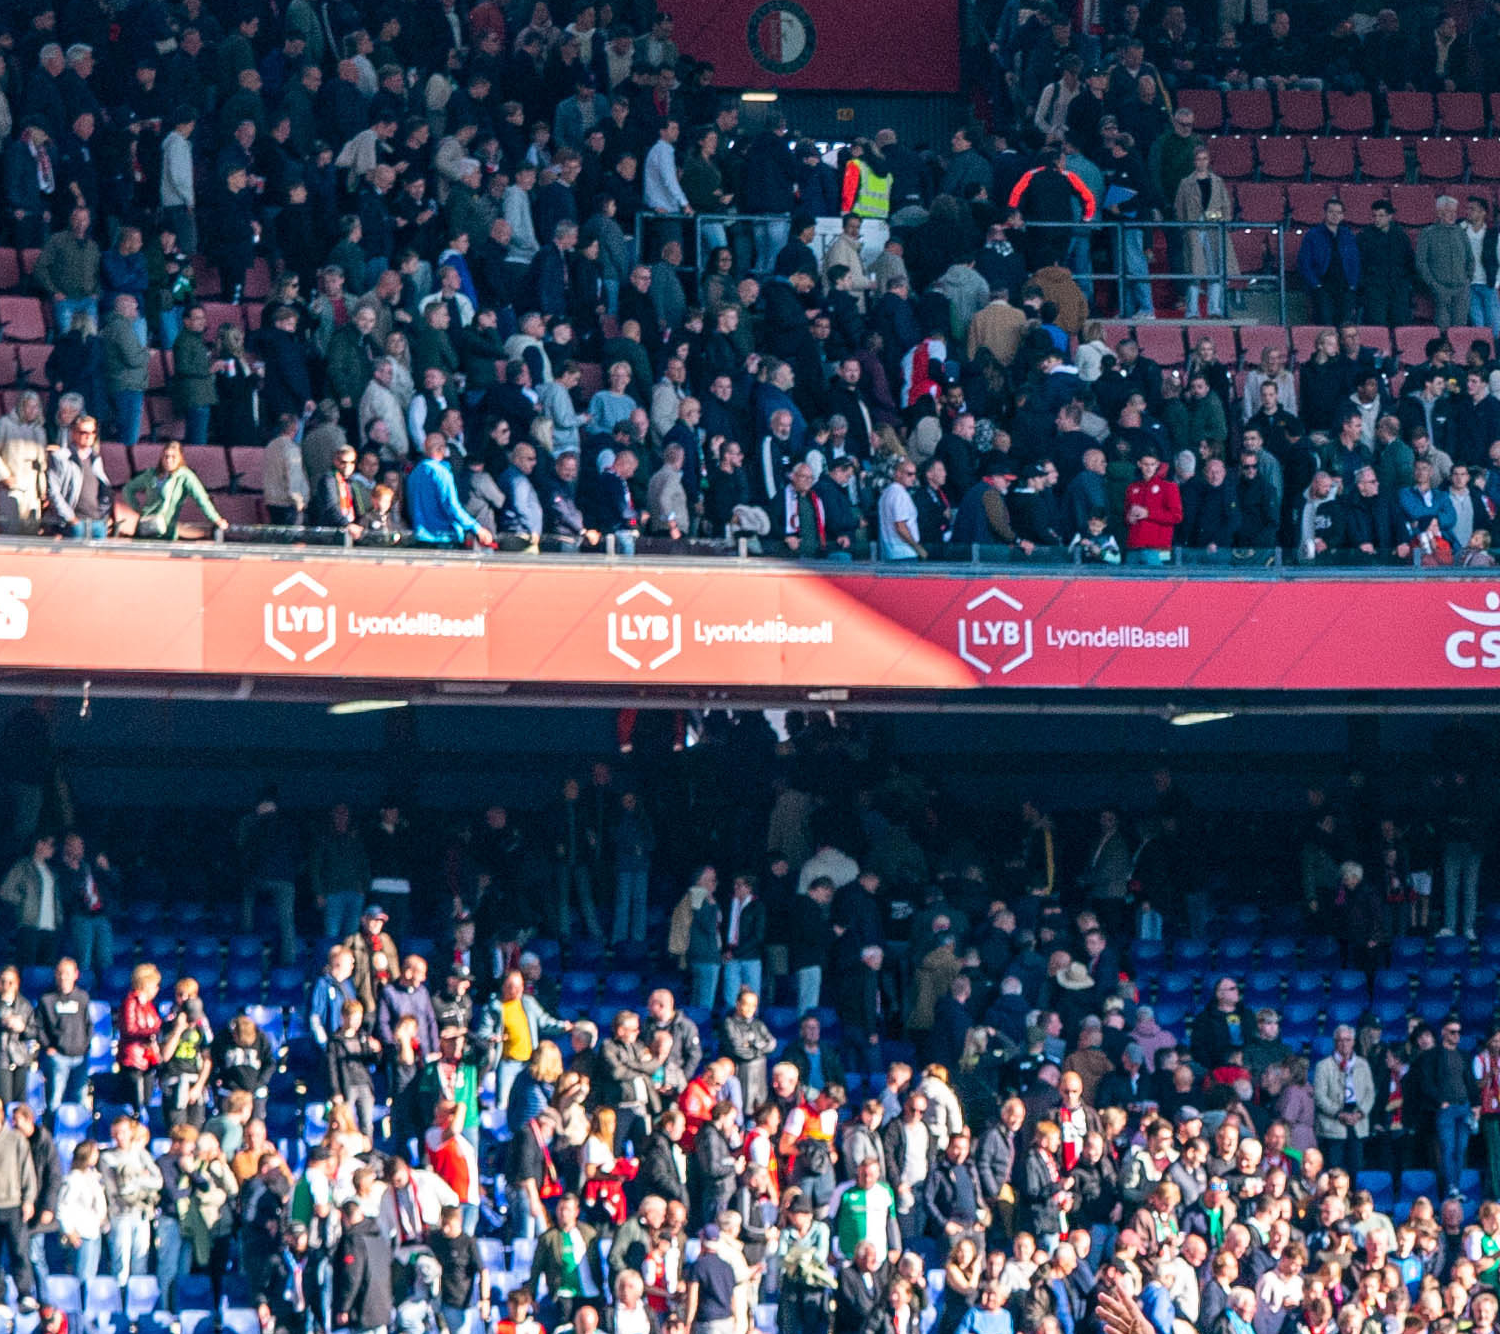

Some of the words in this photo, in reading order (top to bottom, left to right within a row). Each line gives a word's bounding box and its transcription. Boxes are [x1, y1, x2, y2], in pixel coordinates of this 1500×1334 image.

[279, 606, 325, 633] LYB
[347, 610, 485, 639] LyondellBasell
[621, 614, 669, 642] LYB
[693, 619, 833, 647] LyondellBasell
[972, 621, 1020, 646] LYB
[1046, 626, 1190, 651] LyondellBasell
